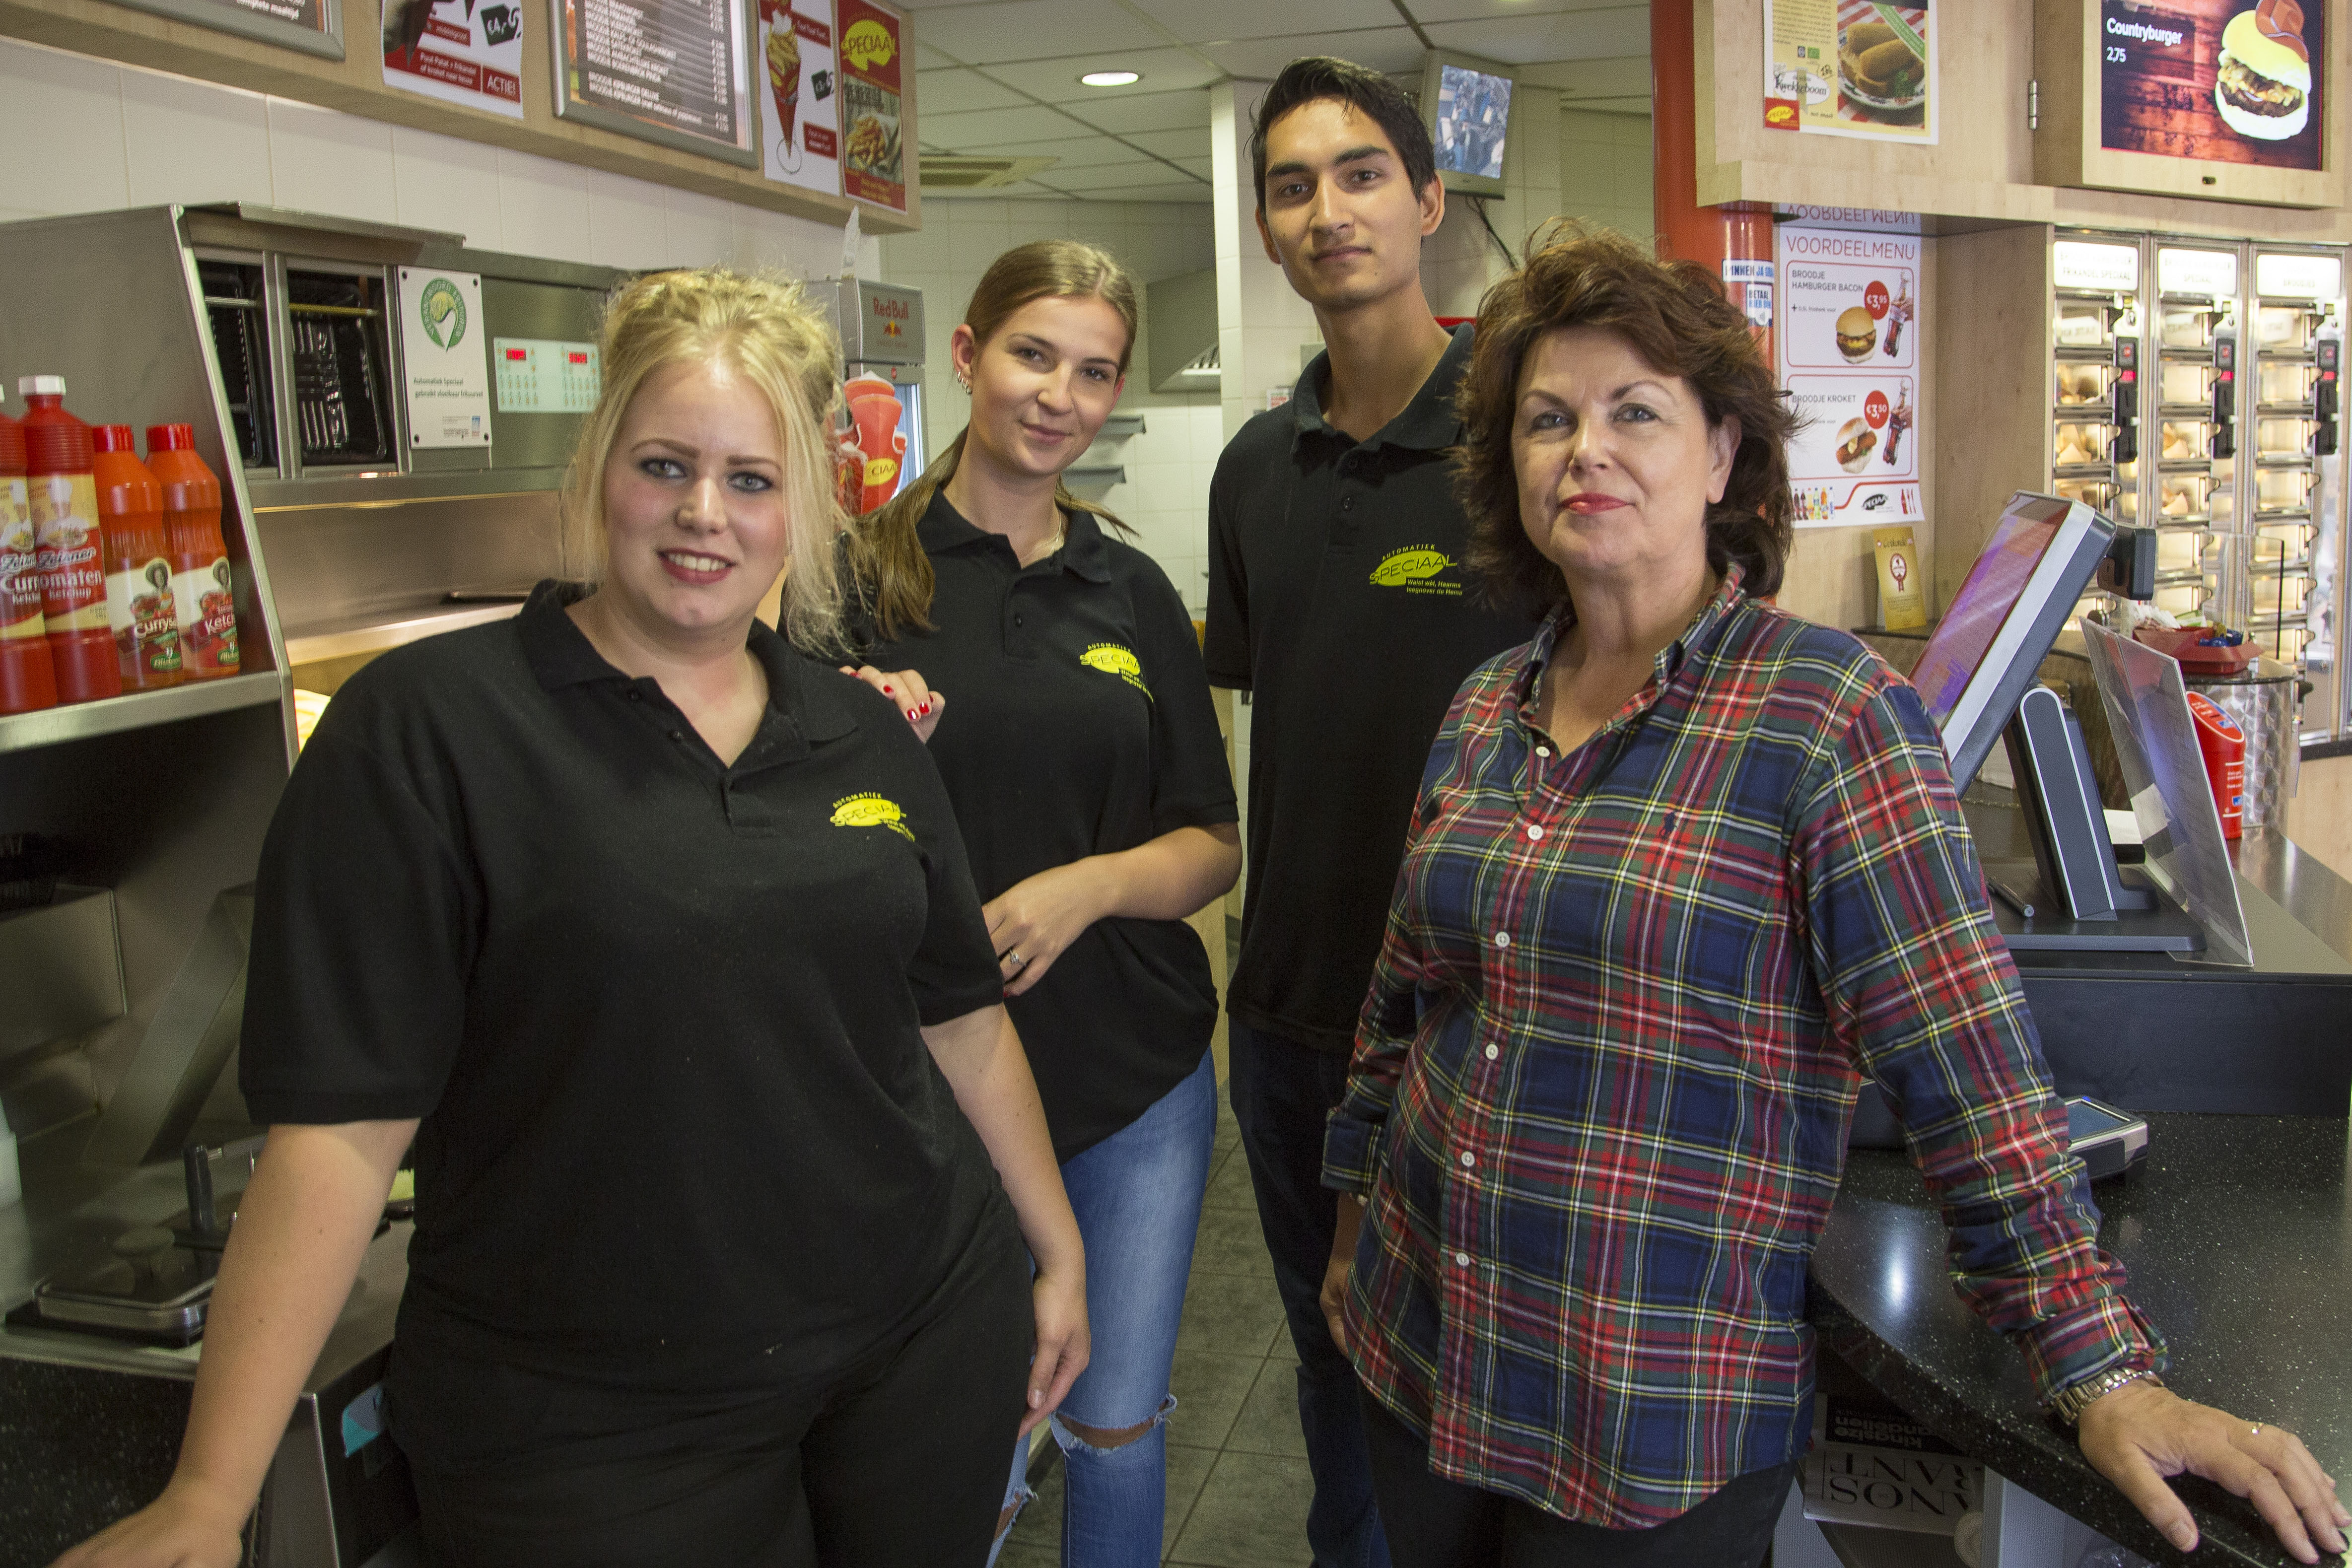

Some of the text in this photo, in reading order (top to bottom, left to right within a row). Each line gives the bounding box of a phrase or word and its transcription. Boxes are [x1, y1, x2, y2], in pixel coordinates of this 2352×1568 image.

[2106, 18, 2183, 46] Countryburger
[841, 34, 898, 60] SPECIAAL
[2107, 47, 2127, 63] 2,75
[487, 74, 516, 96] ACTIE!
[1787, 235, 1915, 261] VOORDEELMENU
[1792, 270, 1825, 279] BROODJE
[1792, 281, 1864, 292] HAMBURGER BACON
[873, 297, 908, 320] Red Bull
[1792, 394, 1857, 403] BROODJE KROKET
[1382, 544, 1436, 561] AUTOMATIEK
[39, 569, 102, 589] omaten
[1369, 554, 1458, 586] SPECIAAL
[0, 573, 39, 595] Curr
